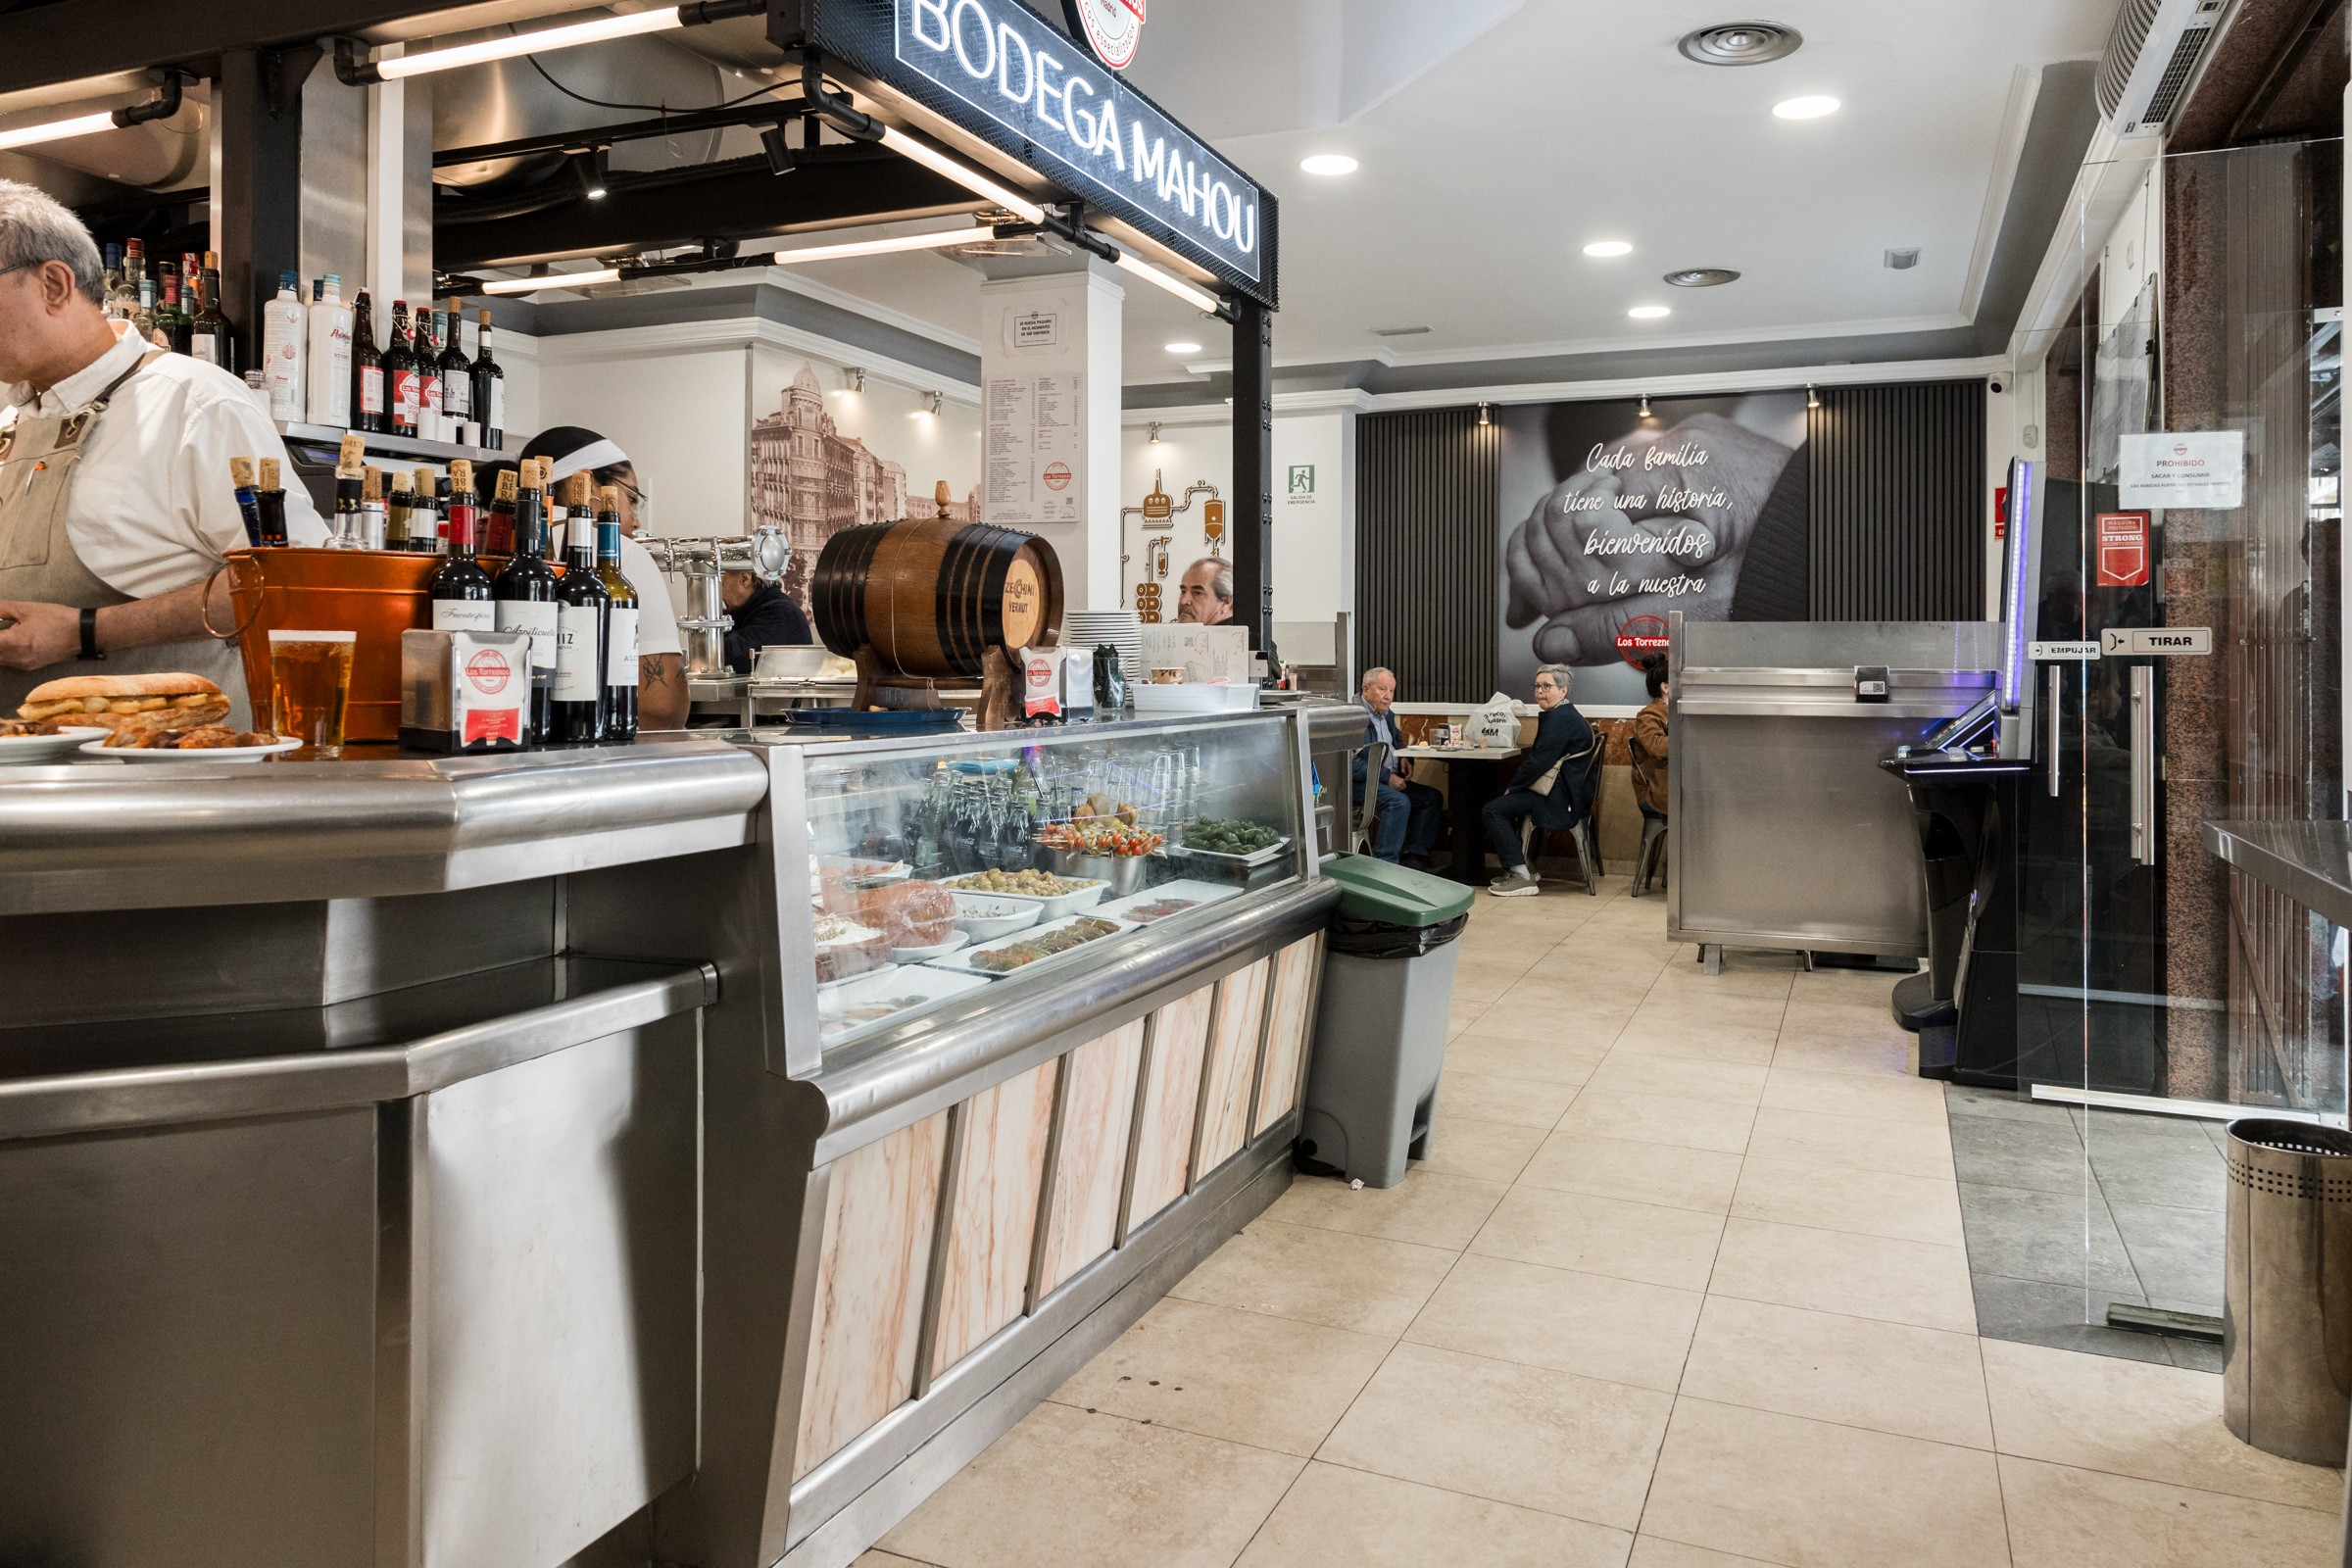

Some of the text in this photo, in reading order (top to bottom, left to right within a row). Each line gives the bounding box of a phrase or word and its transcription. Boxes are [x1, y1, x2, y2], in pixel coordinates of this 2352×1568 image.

[912, 0, 1254, 254] BODEGA MAHOU
[1586, 442, 1709, 472] Cada familia
[2156, 459, 2205, 467] PROHIBIDO
[1562, 485, 1734, 514] tiene una historia,
[1584, 528, 1710, 559] bienvenidos
[1587, 571, 1706, 598] a la nuestra
[1008, 601, 1029, 613] VERMUT
[1617, 637, 1669, 647] Los Torrezn
[2148, 637, 2192, 646] TIRAR
